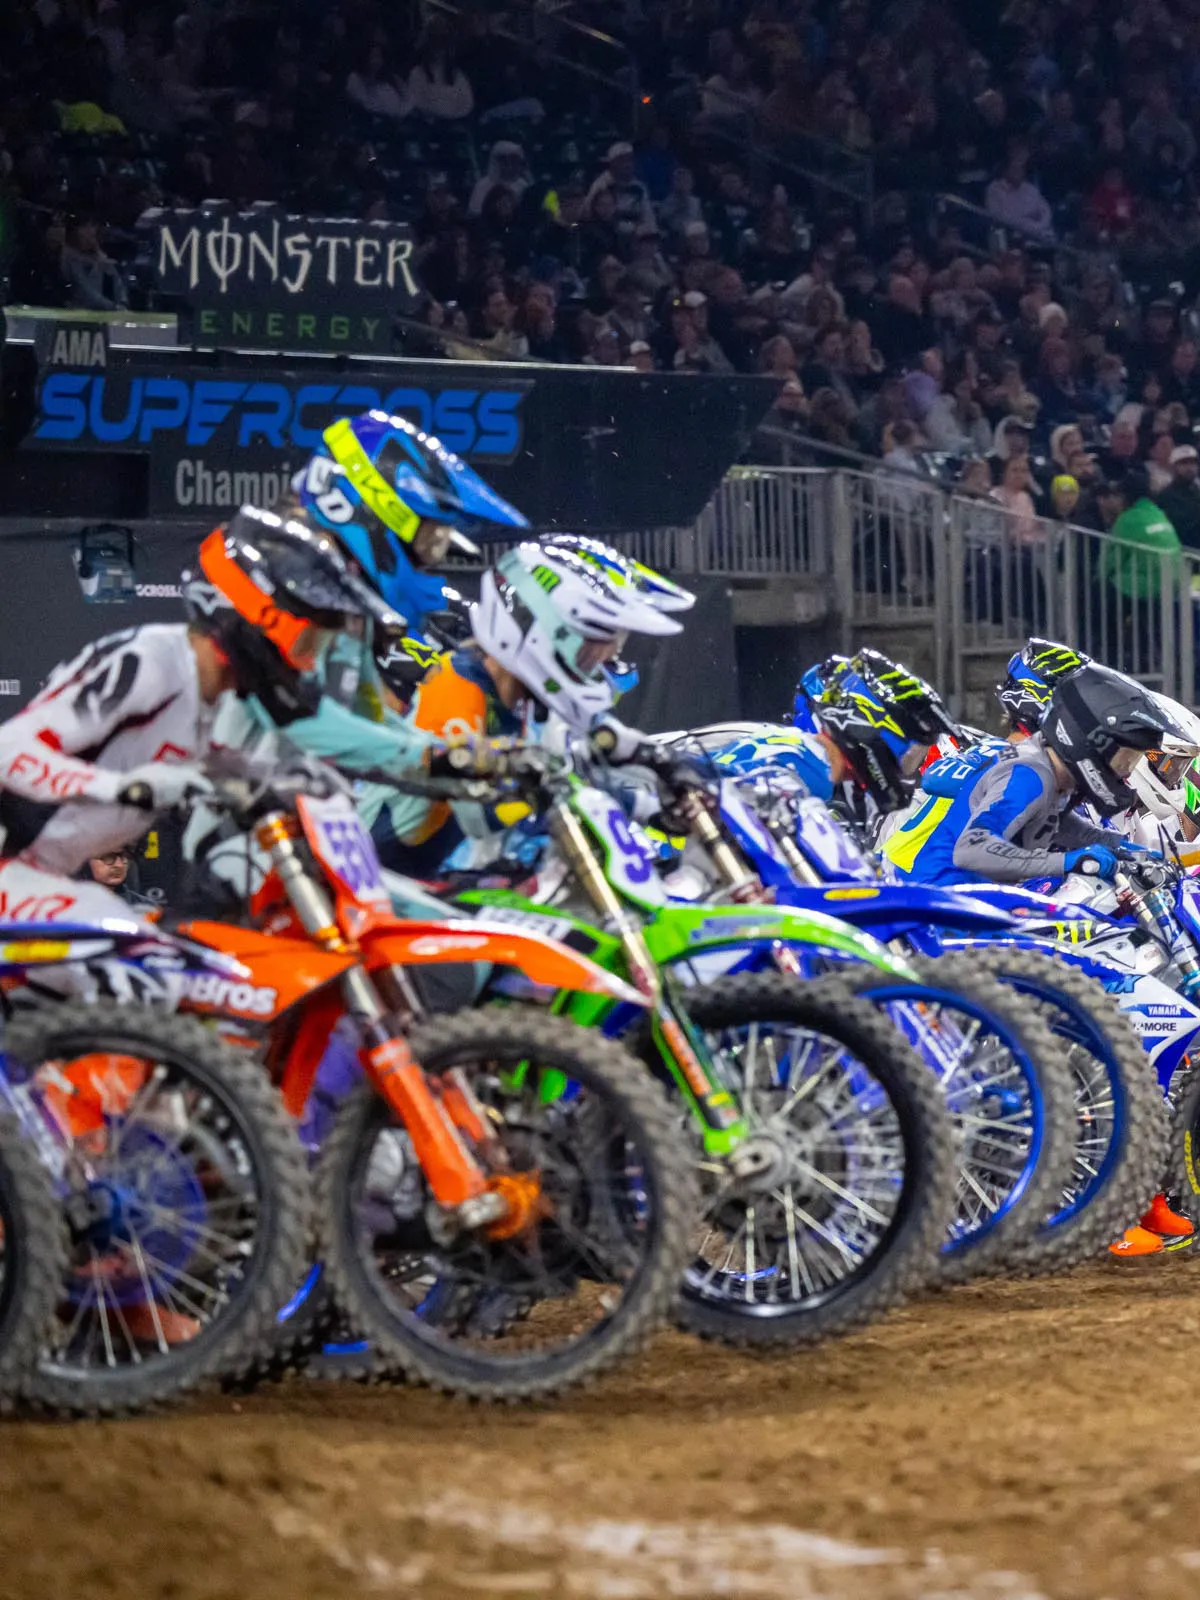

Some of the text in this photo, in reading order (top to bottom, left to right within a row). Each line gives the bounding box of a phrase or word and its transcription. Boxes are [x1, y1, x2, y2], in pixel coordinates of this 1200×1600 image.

[158, 217, 420, 297] MONSTER
[202, 311, 381, 341] ENERGY
[52, 331, 106, 367] AMA
[175, 459, 295, 506] Champi
[1147, 1005, 1182, 1016] YAMAHA
